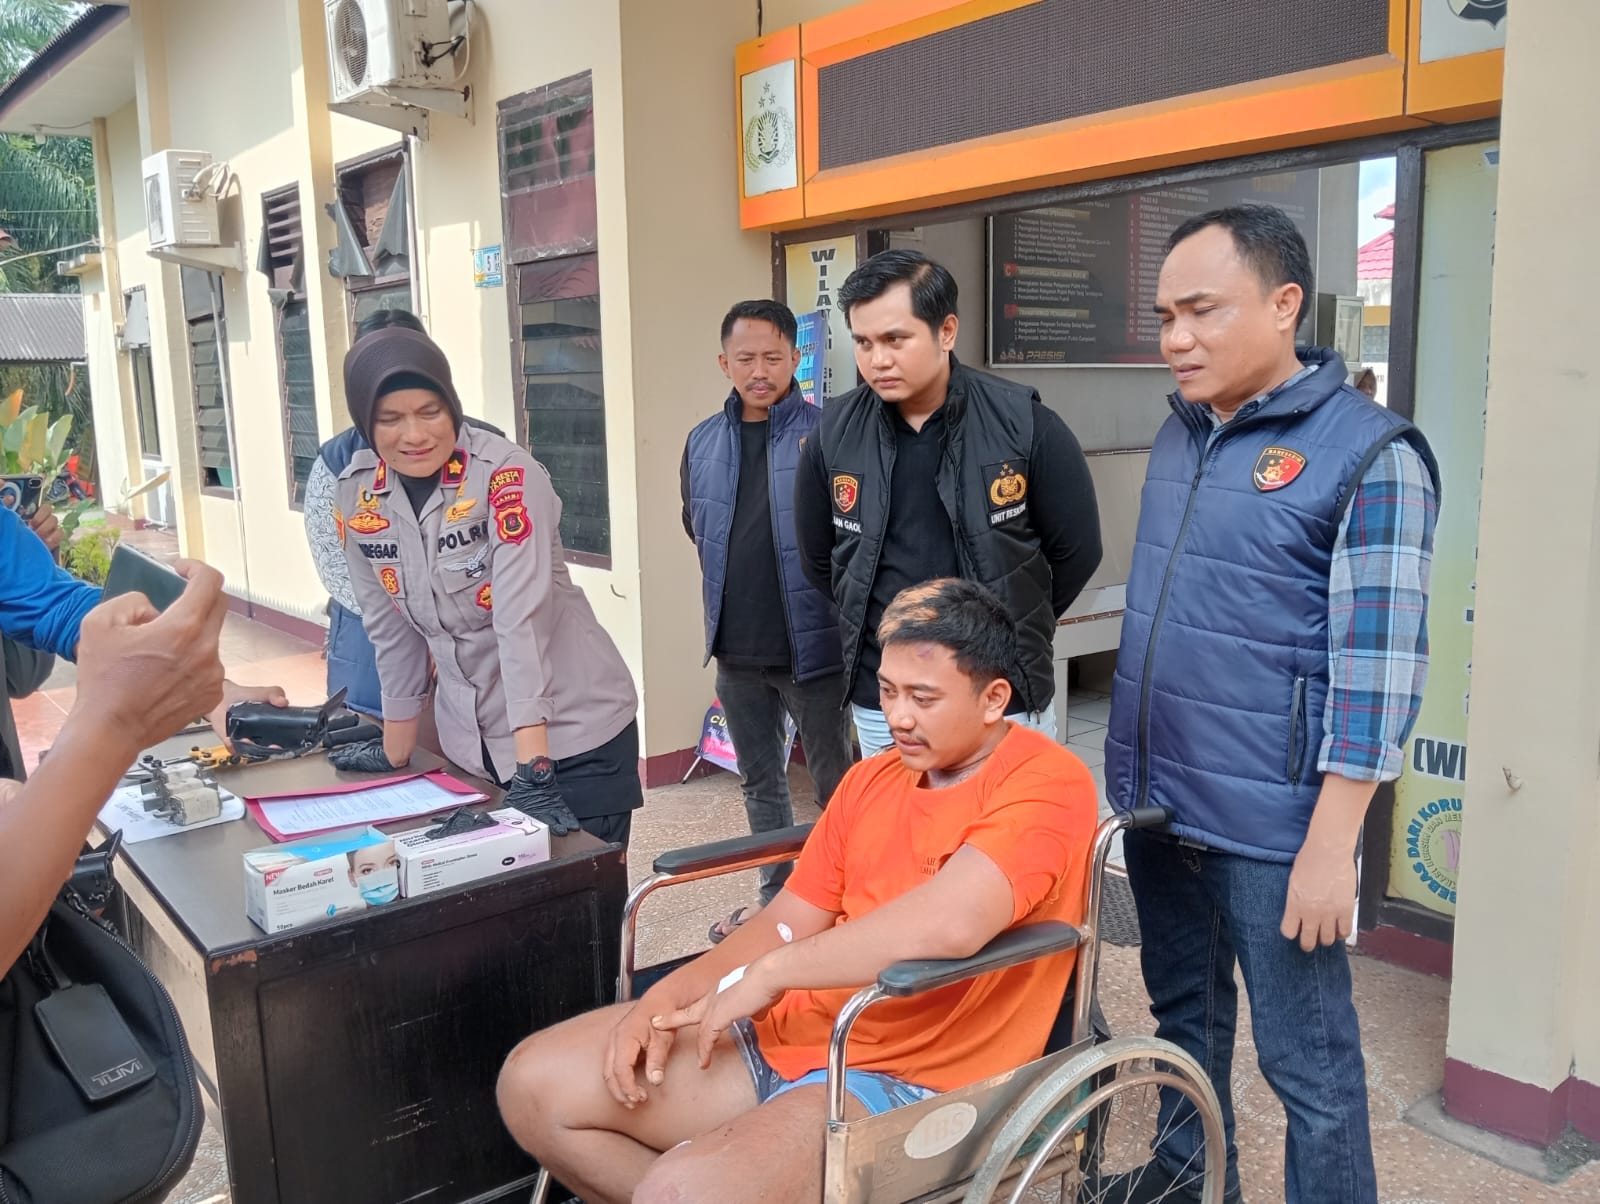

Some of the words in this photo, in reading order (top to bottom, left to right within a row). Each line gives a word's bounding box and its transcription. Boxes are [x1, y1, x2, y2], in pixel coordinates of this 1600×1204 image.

[1025, 350, 1066, 361] PRESISI
[495, 493, 520, 506] JAMBI
[991, 511, 1006, 524] UNIT
[437, 520, 489, 553] POLRI
[1406, 818, 1424, 858] DARI
[265, 871, 282, 881] NEW
[273, 885, 297, 896] Masker
[297, 880, 317, 891] Bedah
[317, 876, 335, 887] Karet
[92, 1058, 144, 1086] TUMI
